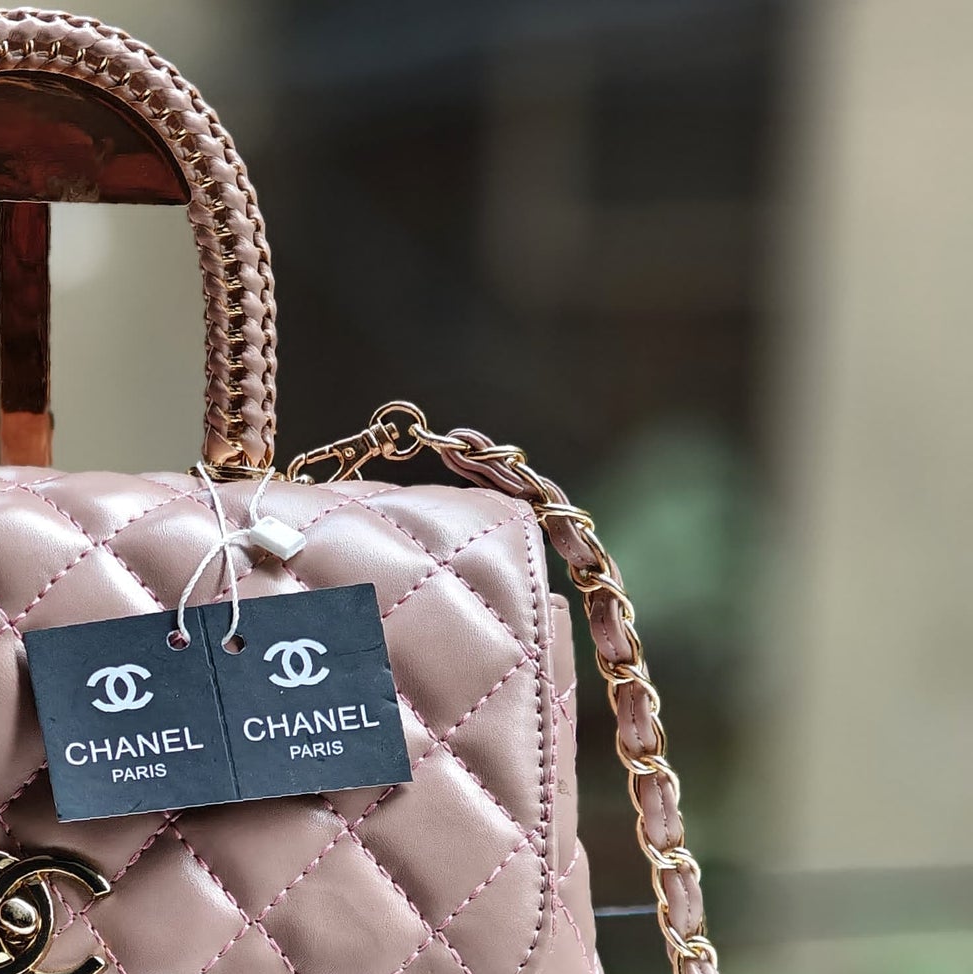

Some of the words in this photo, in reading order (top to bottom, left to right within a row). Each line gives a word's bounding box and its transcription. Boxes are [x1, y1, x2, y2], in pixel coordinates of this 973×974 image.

[243, 705, 380, 742] CHANEL
[64, 726, 204, 766] CHANEL
[289, 741, 345, 760] PARIS
[111, 763, 167, 782] PARIS
